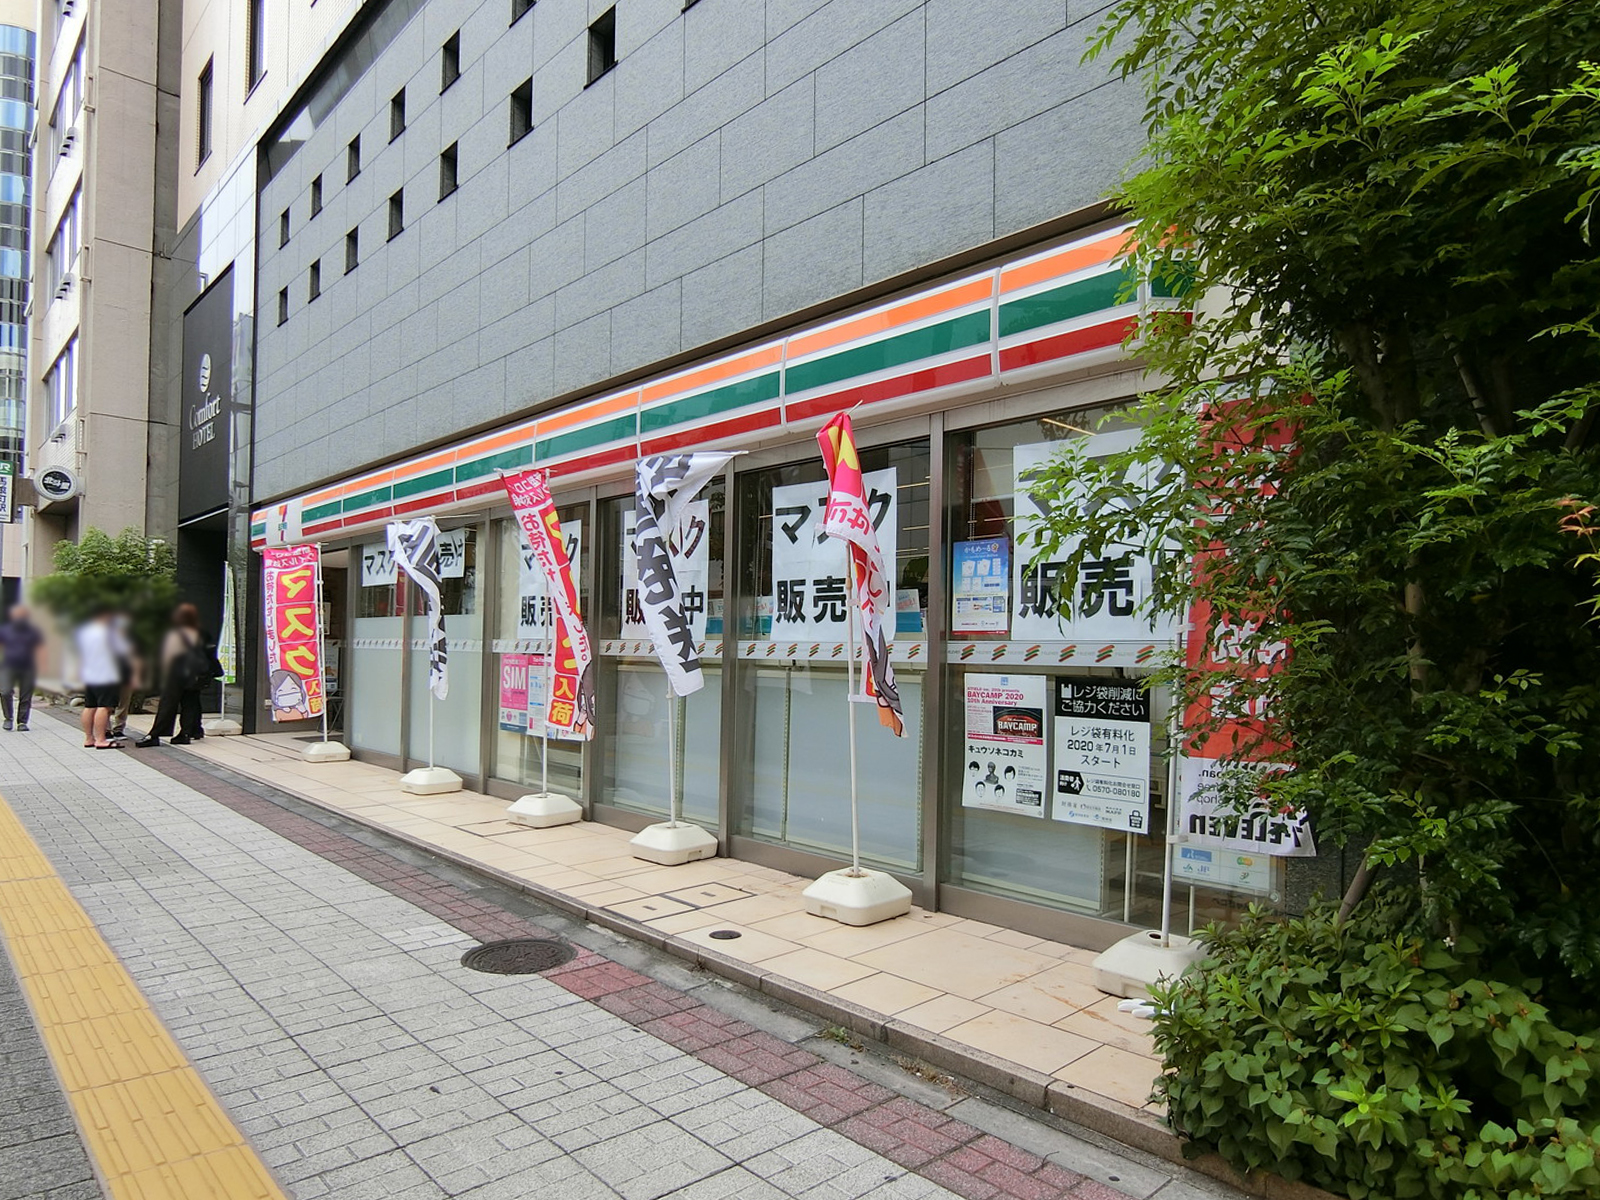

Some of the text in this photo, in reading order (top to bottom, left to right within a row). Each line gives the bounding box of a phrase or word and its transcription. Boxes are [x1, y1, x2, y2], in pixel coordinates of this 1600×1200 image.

[190, 393, 221, 430] Comfort
[192, 421, 216, 450] HOTEL
[626, 584, 704, 625] 販中
[503, 665, 527, 690] SIM
[967, 690, 1024, 701] BAYCAMP 2020
[1073, 685, 1144, 701] レジ袋削減に
[1061, 700, 1145, 715] ご協力ください
[997, 720, 1038, 732] BAYCAMP
[1071, 726, 1135, 742] レジ袋有料化
[968, 745, 1024, 758] キュウソネコカミ
[1081, 755, 1121, 769] スタート
